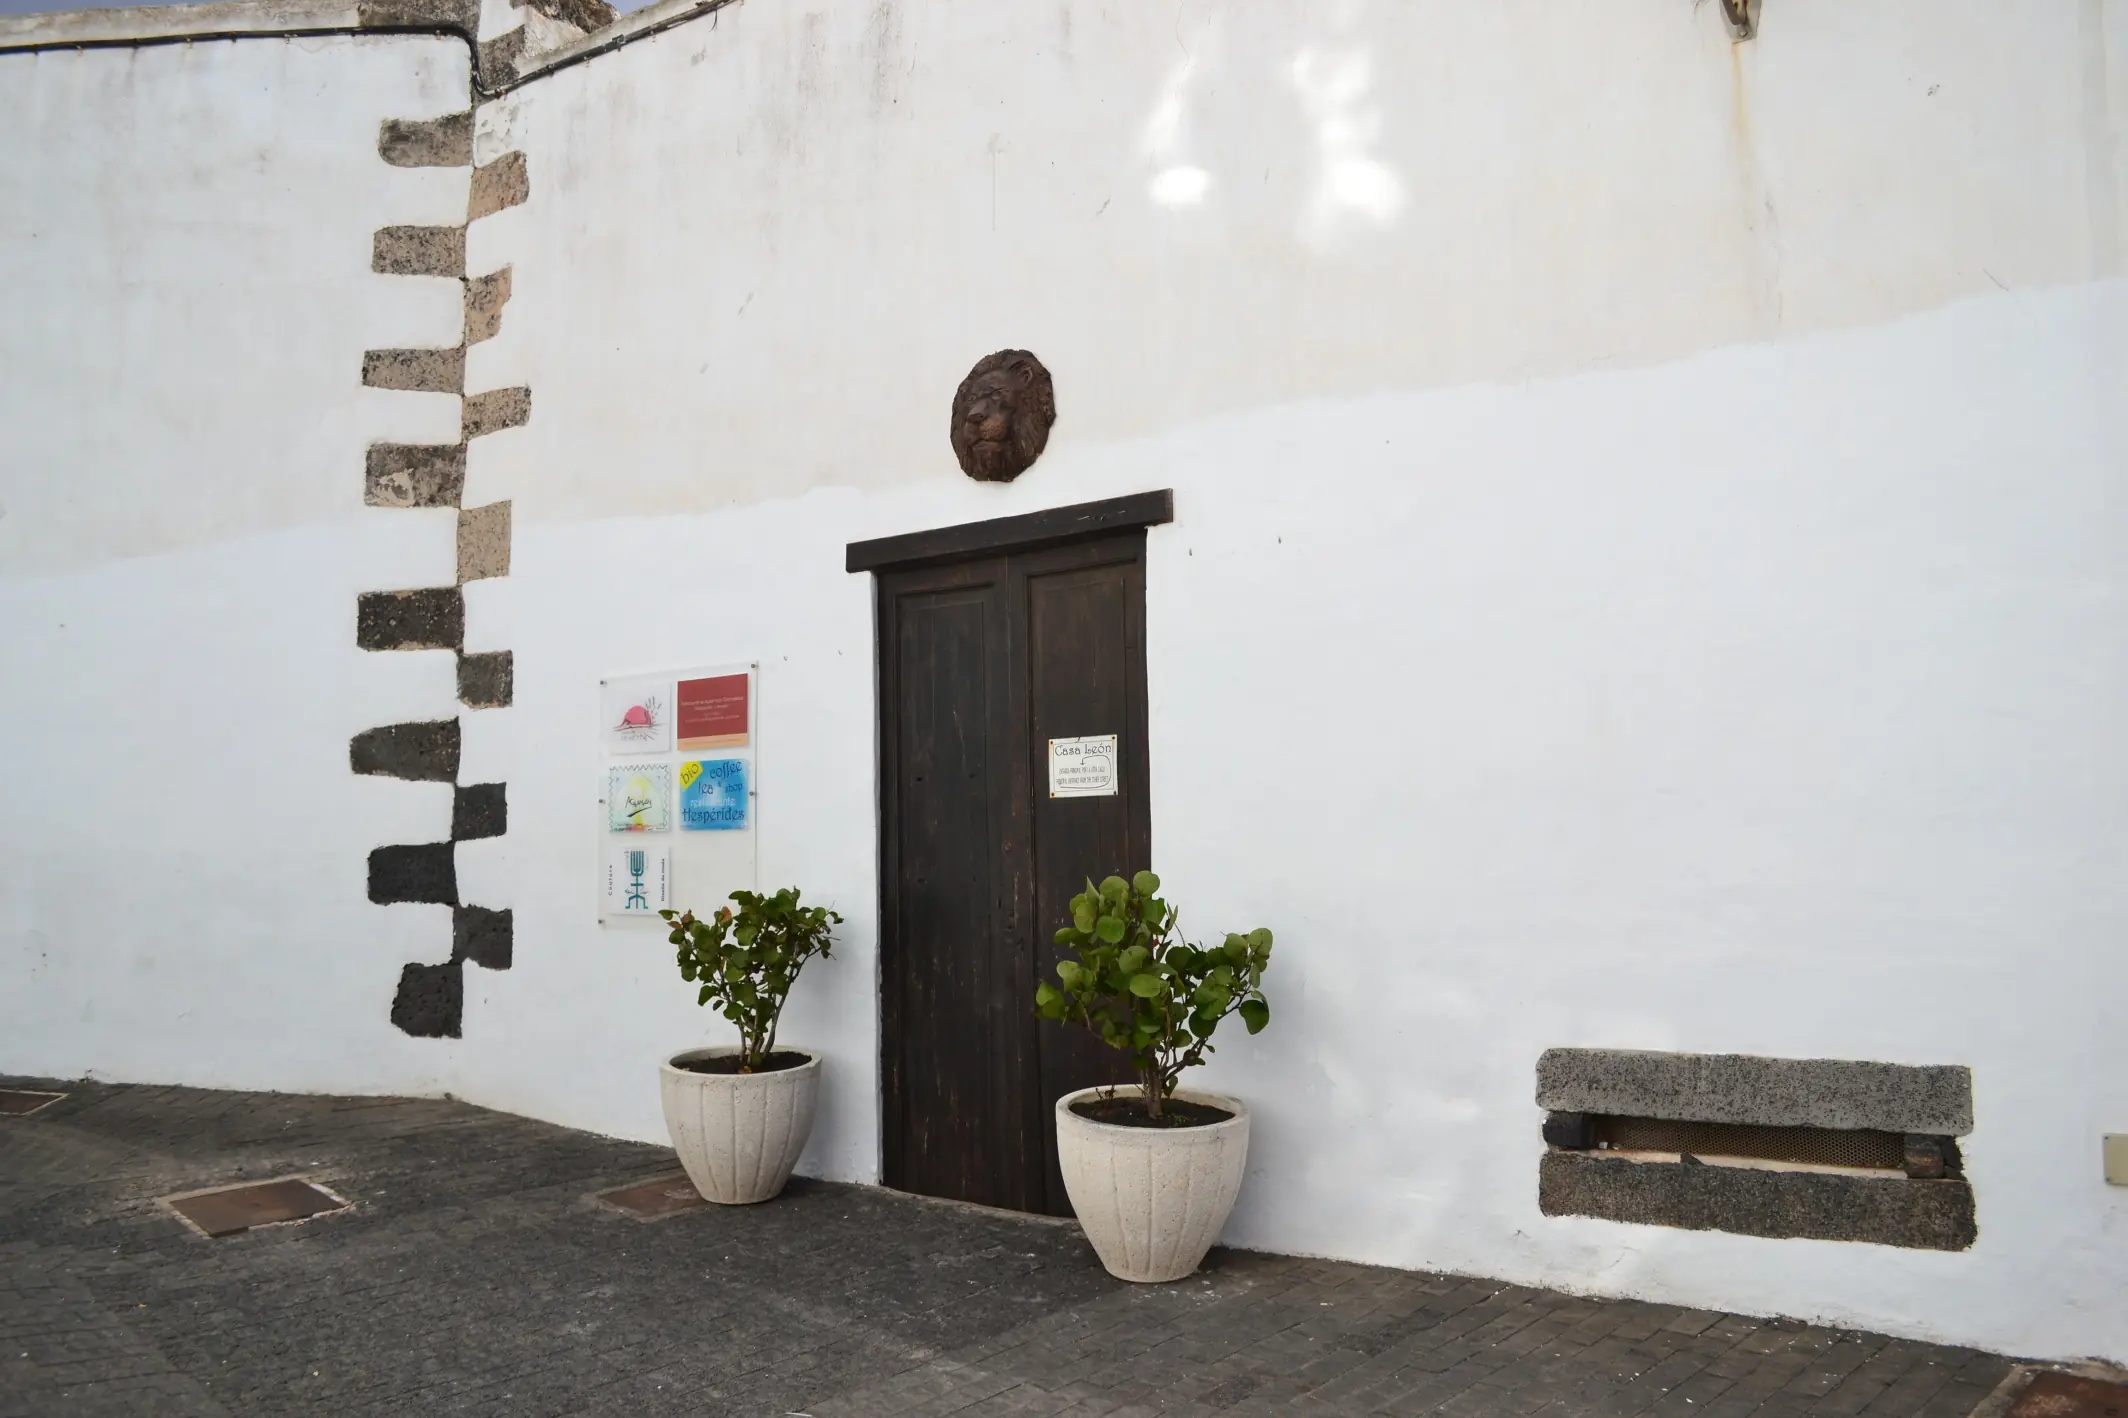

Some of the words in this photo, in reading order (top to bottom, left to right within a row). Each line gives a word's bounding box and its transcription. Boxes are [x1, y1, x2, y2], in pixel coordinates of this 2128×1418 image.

[1055, 744, 1080, 756] Casa
[1084, 742, 1112, 754] León
[680, 763, 700, 784] bio
[710, 760, 742, 779] coffee
[698, 782, 714, 794] tea
[725, 783, 743, 793] shop
[682, 808, 744, 824] Hespérides
